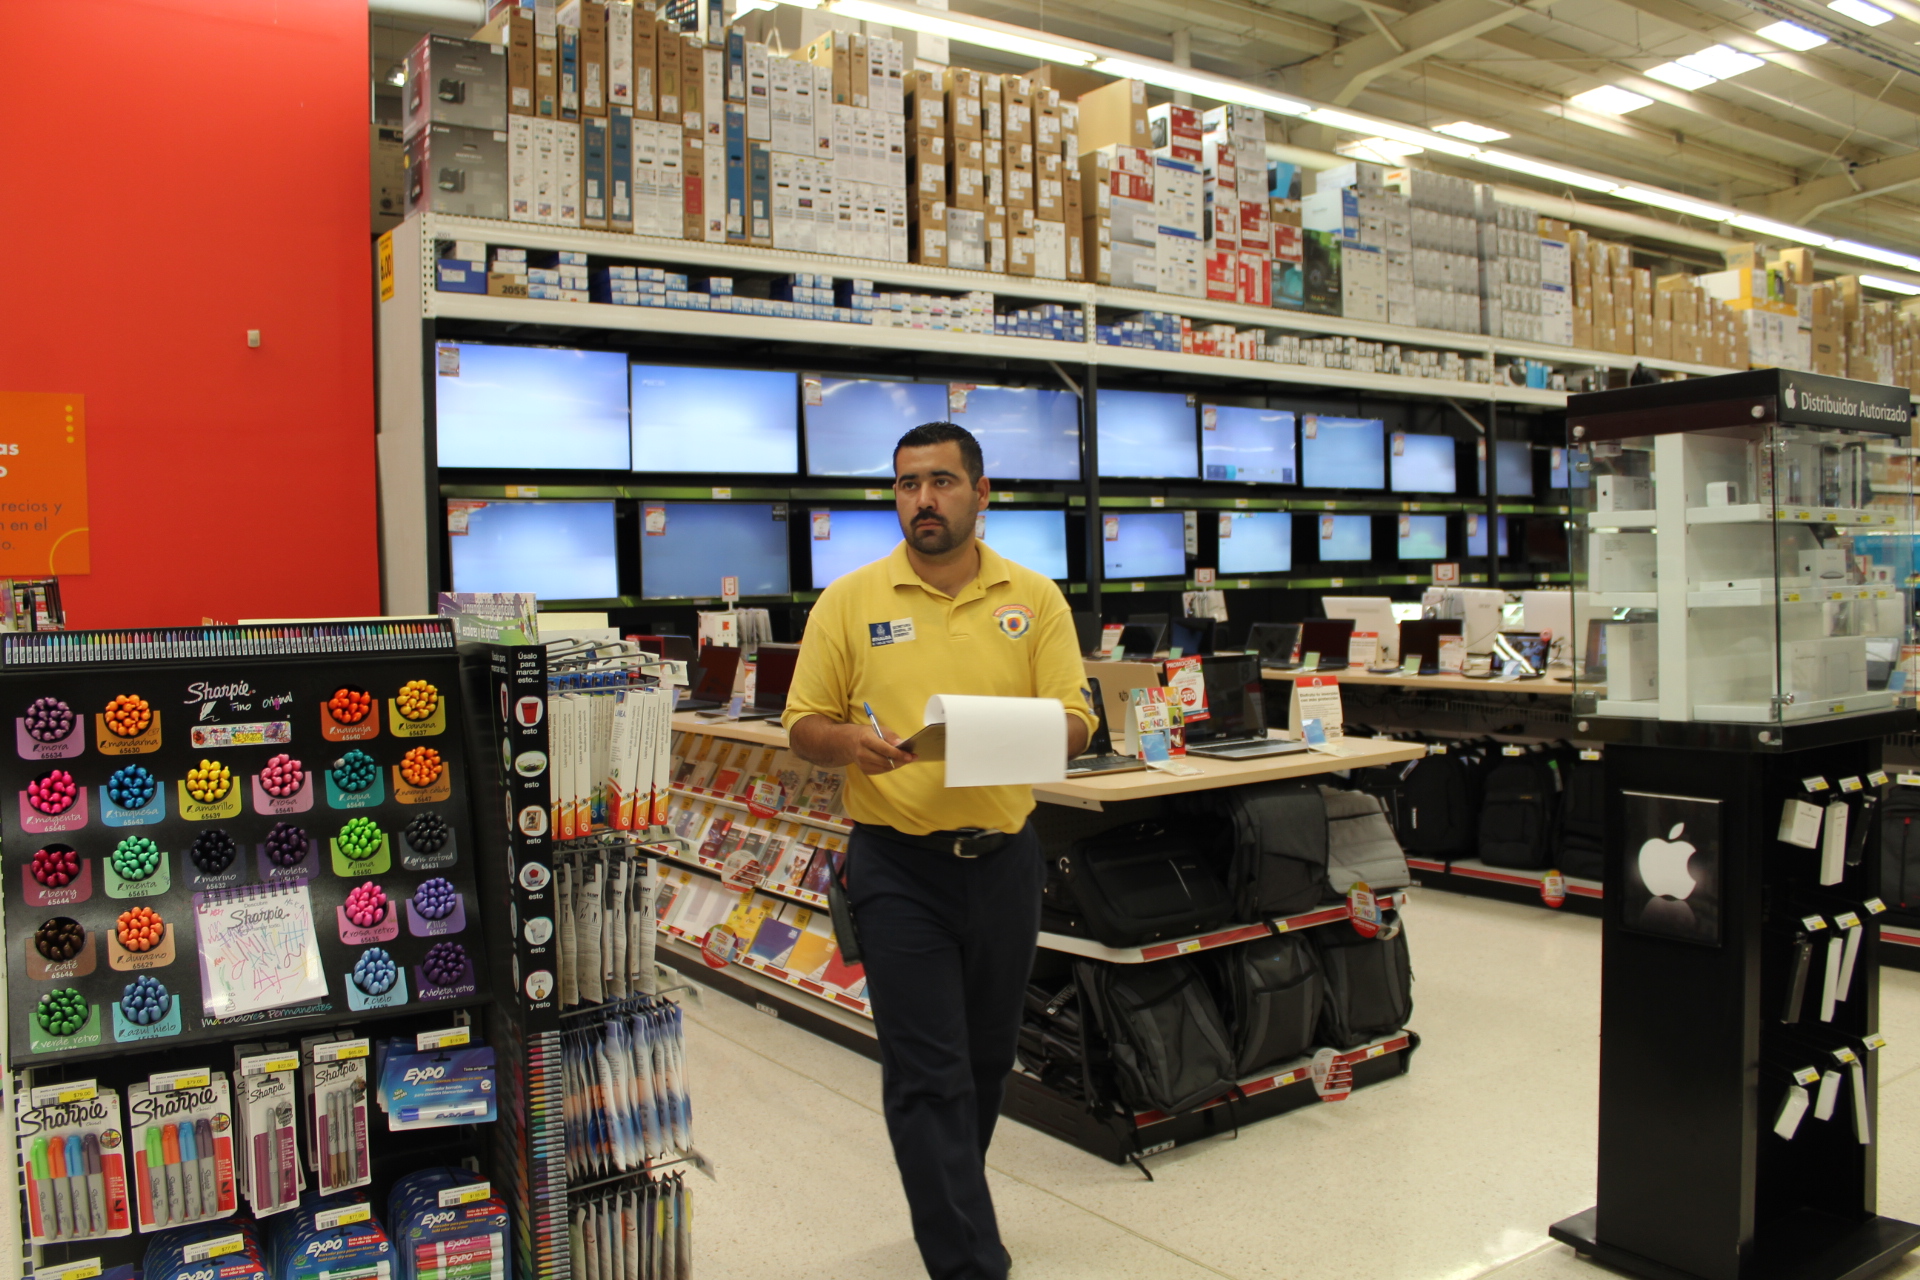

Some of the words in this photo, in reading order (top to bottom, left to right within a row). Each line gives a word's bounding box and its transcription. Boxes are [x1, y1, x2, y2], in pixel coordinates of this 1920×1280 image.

[1801, 392, 1857, 416] Distribuidor
[1859, 400, 1907, 422] Autorizado
[54, 503, 62, 515] y
[34, 517, 47, 531] el
[518, 652, 537, 660] Úsalo
[230, 702, 251, 711] Fino
[337, 725, 372, 735] naranja
[406, 722, 436, 730] banana
[41, 743, 69, 751] mora
[109, 738, 158, 747] mandarina
[347, 793, 371, 802] aqua
[195, 802, 234, 812] amarillo
[114, 808, 158, 818] turquesa
[35, 814, 82, 825] magenta
[411, 857, 426, 866] gris
[429, 853, 453, 862] oxford
[278, 866, 308, 875] violeta
[202, 874, 236, 882] marino
[126, 881, 157, 890] menta
[206, 882, 226, 890] 65632
[48, 889, 77, 899] berry
[374, 926, 395, 935] retro
[126, 952, 167, 962] durazno
[55, 960, 78, 971] café
[426, 987, 453, 997] violeta
[455, 984, 475, 993] retro
[372, 995, 392, 1005] cielo
[201, 1011, 265, 1028] Macadores
[267, 1002, 332, 1019] Permanentes
[127, 1026, 150, 1036] azul
[152, 1024, 176, 1033] hielo
[41, 1036, 69, 1048] verde
[74, 1034, 98, 1044] retro
[314, 1062, 358, 1088] Sharpie
[403, 1066, 444, 1086] EXPO
[249, 1082, 285, 1104] Sharpie
[131, 1087, 218, 1128] Sharpie
[20, 1101, 107, 1137] Sharpie
[421, 1211, 456, 1228] EXPO
[306, 1238, 342, 1257] EXPO
[446, 1238, 471, 1250] EXPO
[448, 1253, 473, 1265] EXPO
[448, 1264, 472, 1275] EXPO
